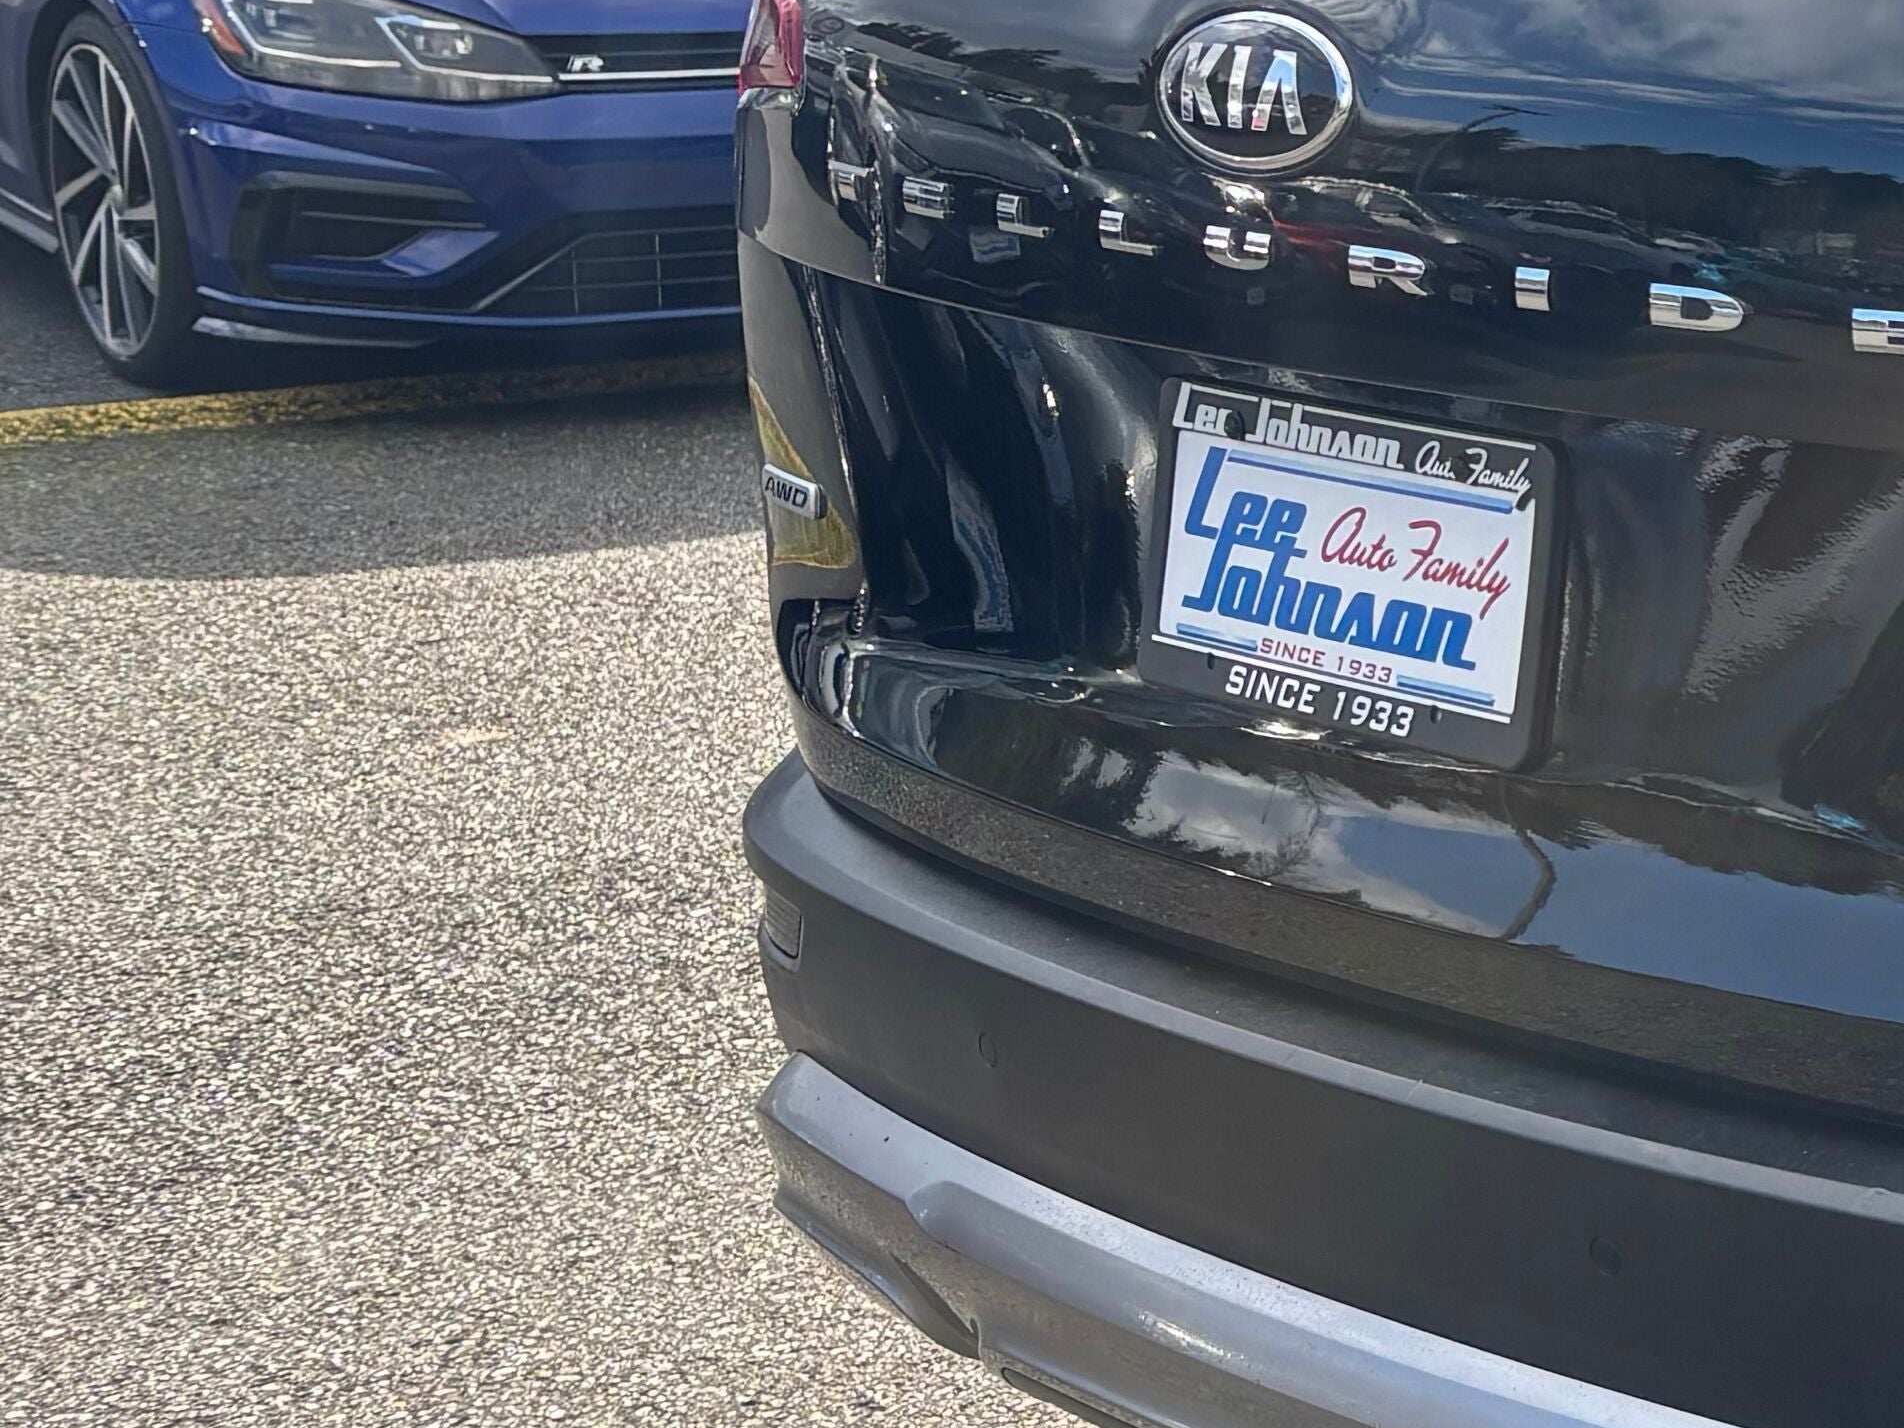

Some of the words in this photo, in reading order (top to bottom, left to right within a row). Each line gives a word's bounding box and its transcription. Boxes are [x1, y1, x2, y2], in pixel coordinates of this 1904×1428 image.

[1181, 42, 1307, 135] KIA
[765, 476, 808, 508] AWD
[1184, 446, 1308, 548] Lee
[1245, 397, 1405, 470] Johnson
[1465, 447, 1532, 510] Family
[1181, 540, 1476, 671] Johnson
[1321, 506, 1397, 573] Auto
[1403, 519, 1511, 620] Family
[1225, 664, 1321, 714] SINCE
[1333, 699, 1416, 738] 1933
[1259, 637, 1326, 668] SINCE
[1337, 655, 1393, 683] 1933
